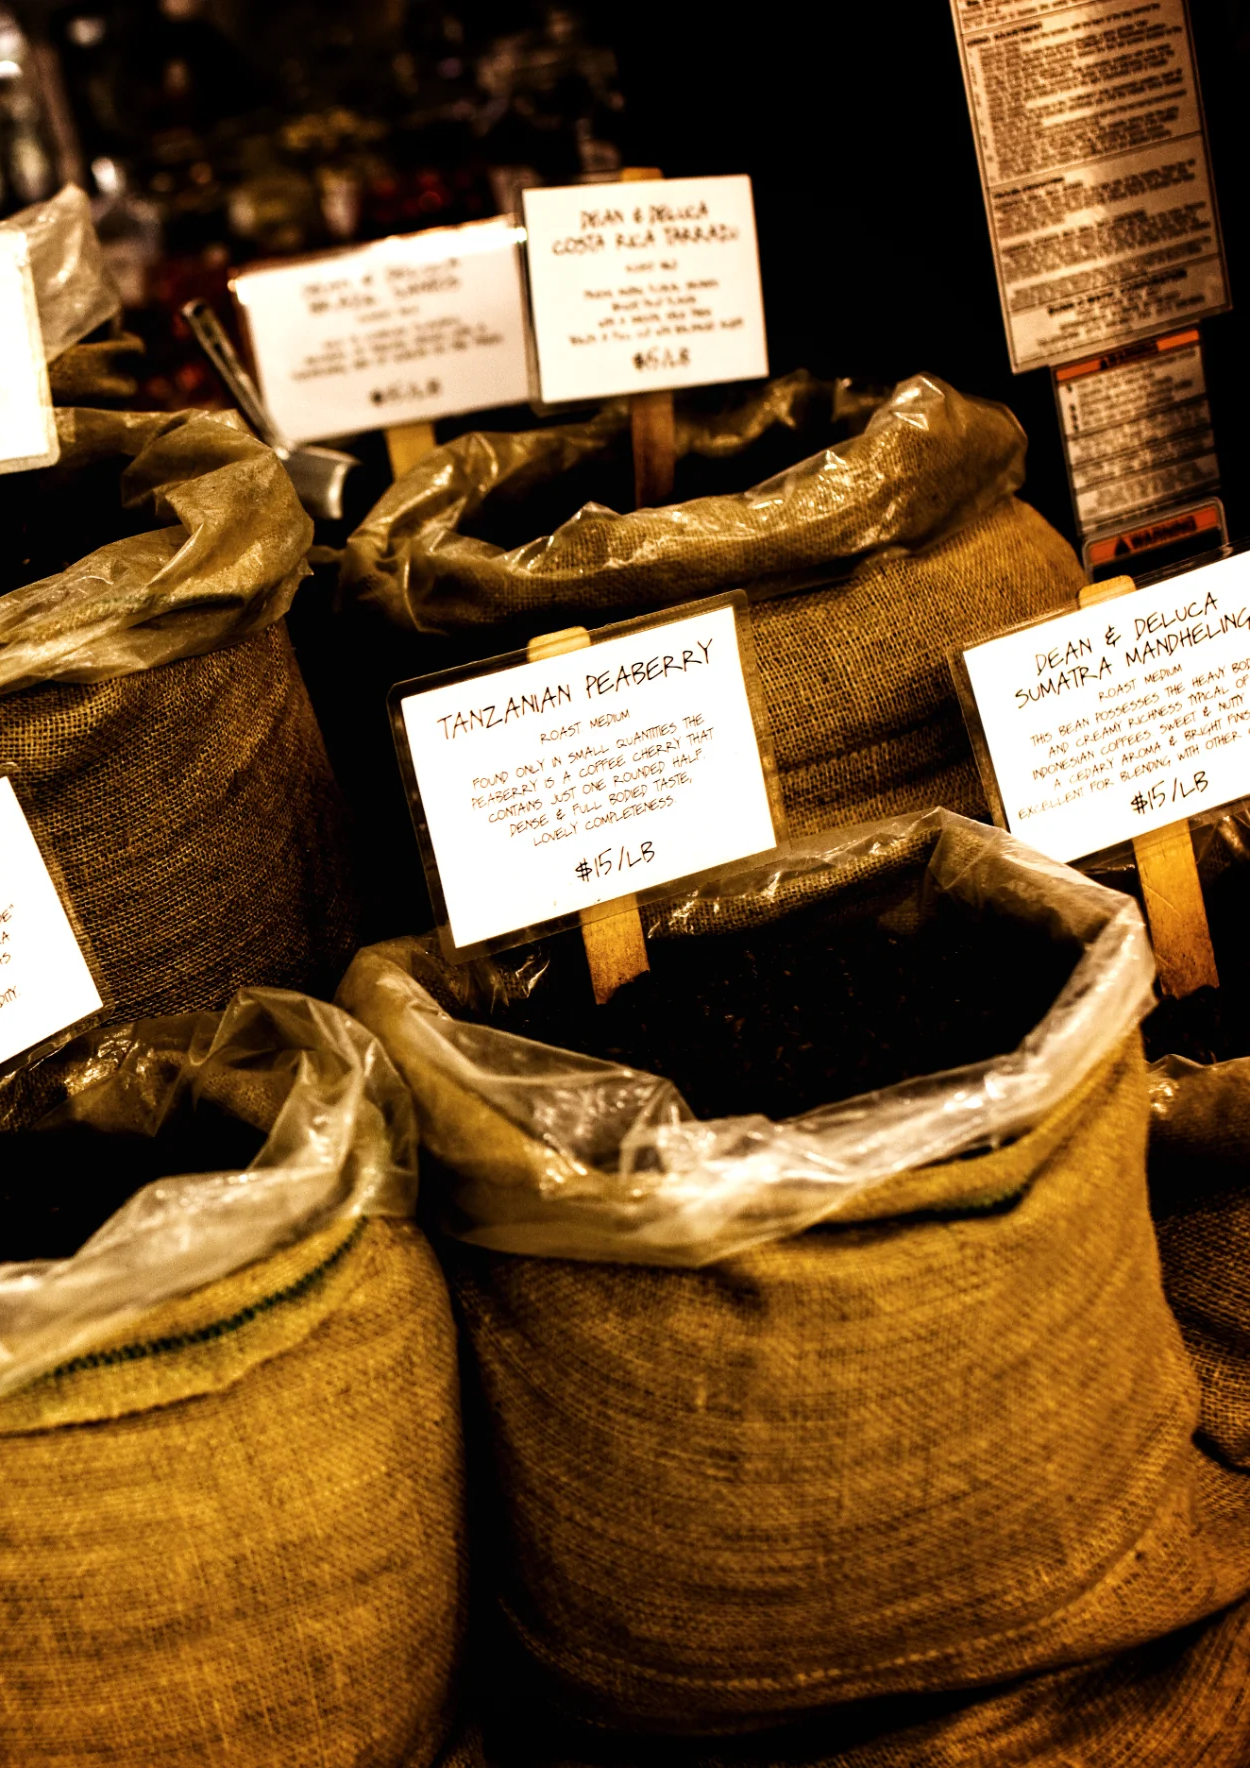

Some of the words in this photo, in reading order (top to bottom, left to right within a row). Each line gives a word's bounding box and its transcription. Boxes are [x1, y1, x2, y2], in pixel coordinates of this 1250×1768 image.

[1015, 656, 1112, 709] SUMATRA
[1126, 607, 1250, 667] MANDHELING
[1035, 638, 1092, 676] DEAN
[1105, 625, 1121, 647] &
[1134, 592, 1217, 641] DELUCA
[437, 684, 571, 739] TANZANIAN
[586, 638, 712, 699] PEABERRY
[590, 709, 630, 729] MEDIUM
[1030, 732, 1052, 746] THIS
[1058, 718, 1089, 736] BEAN
[1095, 693, 1160, 723] POSSESSES
[1164, 682, 1185, 697] THE
[1192, 666, 1225, 687] HEAVY
[1049, 742, 1069, 758] AND
[1076, 721, 1121, 747] CREAMY
[1128, 701, 1182, 729] RICHNESS
[1188, 686, 1229, 705] TYPICAL
[1235, 674, 1250, 688] OF
[1099, 678, 1136, 702] ROAST
[1144, 664, 1182, 684] MEDIUM
[472, 771, 508, 789] FOUND
[516, 759, 544, 778] ONLY
[552, 756, 562, 768] IN
[568, 745, 609, 764] SMALL
[616, 722, 677, 748] QUANTITIES
[682, 713, 704, 728] THE
[472, 779, 537, 809] PEABERRY
[544, 777, 554, 788] IS
[563, 771, 571, 784] A
[579, 754, 626, 778] COFFEE
[632, 737, 681, 761] CHERRY
[686, 727, 713, 745] THAT
[1033, 751, 1094, 780] INDONESIAN
[1160, 711, 1196, 734] SWEET
[1203, 706, 1211, 717] &
[1218, 693, 1244, 711] NUTTY
[1054, 778, 1061, 790] A
[1069, 758, 1113, 783] CEDARY
[1122, 742, 1161, 765] AROMA
[1169, 735, 1177, 746] &
[1184, 718, 1222, 741] BRIGHT
[489, 799, 542, 823] CONTAINS
[551, 786, 576, 805] JUST
[582, 779, 606, 794] ONE
[613, 761, 665, 787] ROUNDED
[510, 814, 549, 837] DENSE
[556, 809, 565, 820] &
[572, 802, 602, 816] FULL
[609, 785, 647, 805] BODIED
[653, 772, 692, 791] TASTE,
[1018, 787, 1083, 820] EXCELLENT
[1090, 778, 1114, 792] FOR
[1120, 756, 1171, 782] BLENDING
[1177, 744, 1199, 761] WITH
[1205, 731, 1242, 750] OTHER
[1130, 771, 1208, 814] $15/LB
[534, 822, 578, 846] LOVELY
[575, 841, 655, 882] $15/LB
